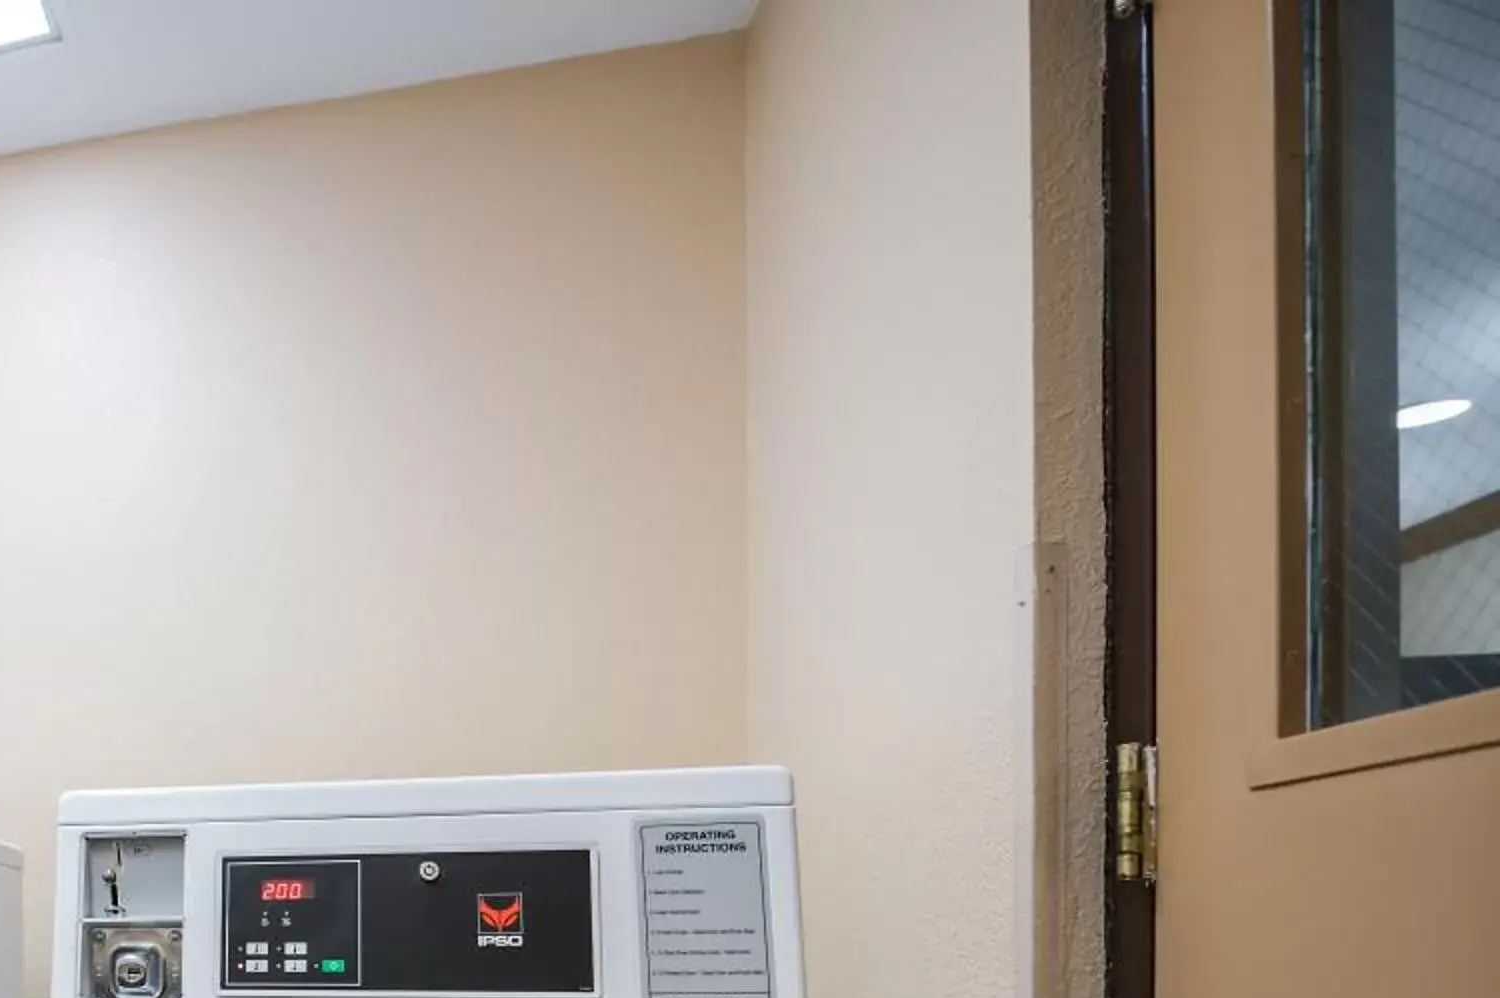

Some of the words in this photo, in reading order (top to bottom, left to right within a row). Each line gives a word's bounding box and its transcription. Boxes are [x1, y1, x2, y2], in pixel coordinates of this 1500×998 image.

[664, 829, 736, 841] OPERATING
[655, 841, 747, 854] INSTRUCTIONS
[262, 882, 303, 900] 200
[477, 935, 523, 947] IPSO
